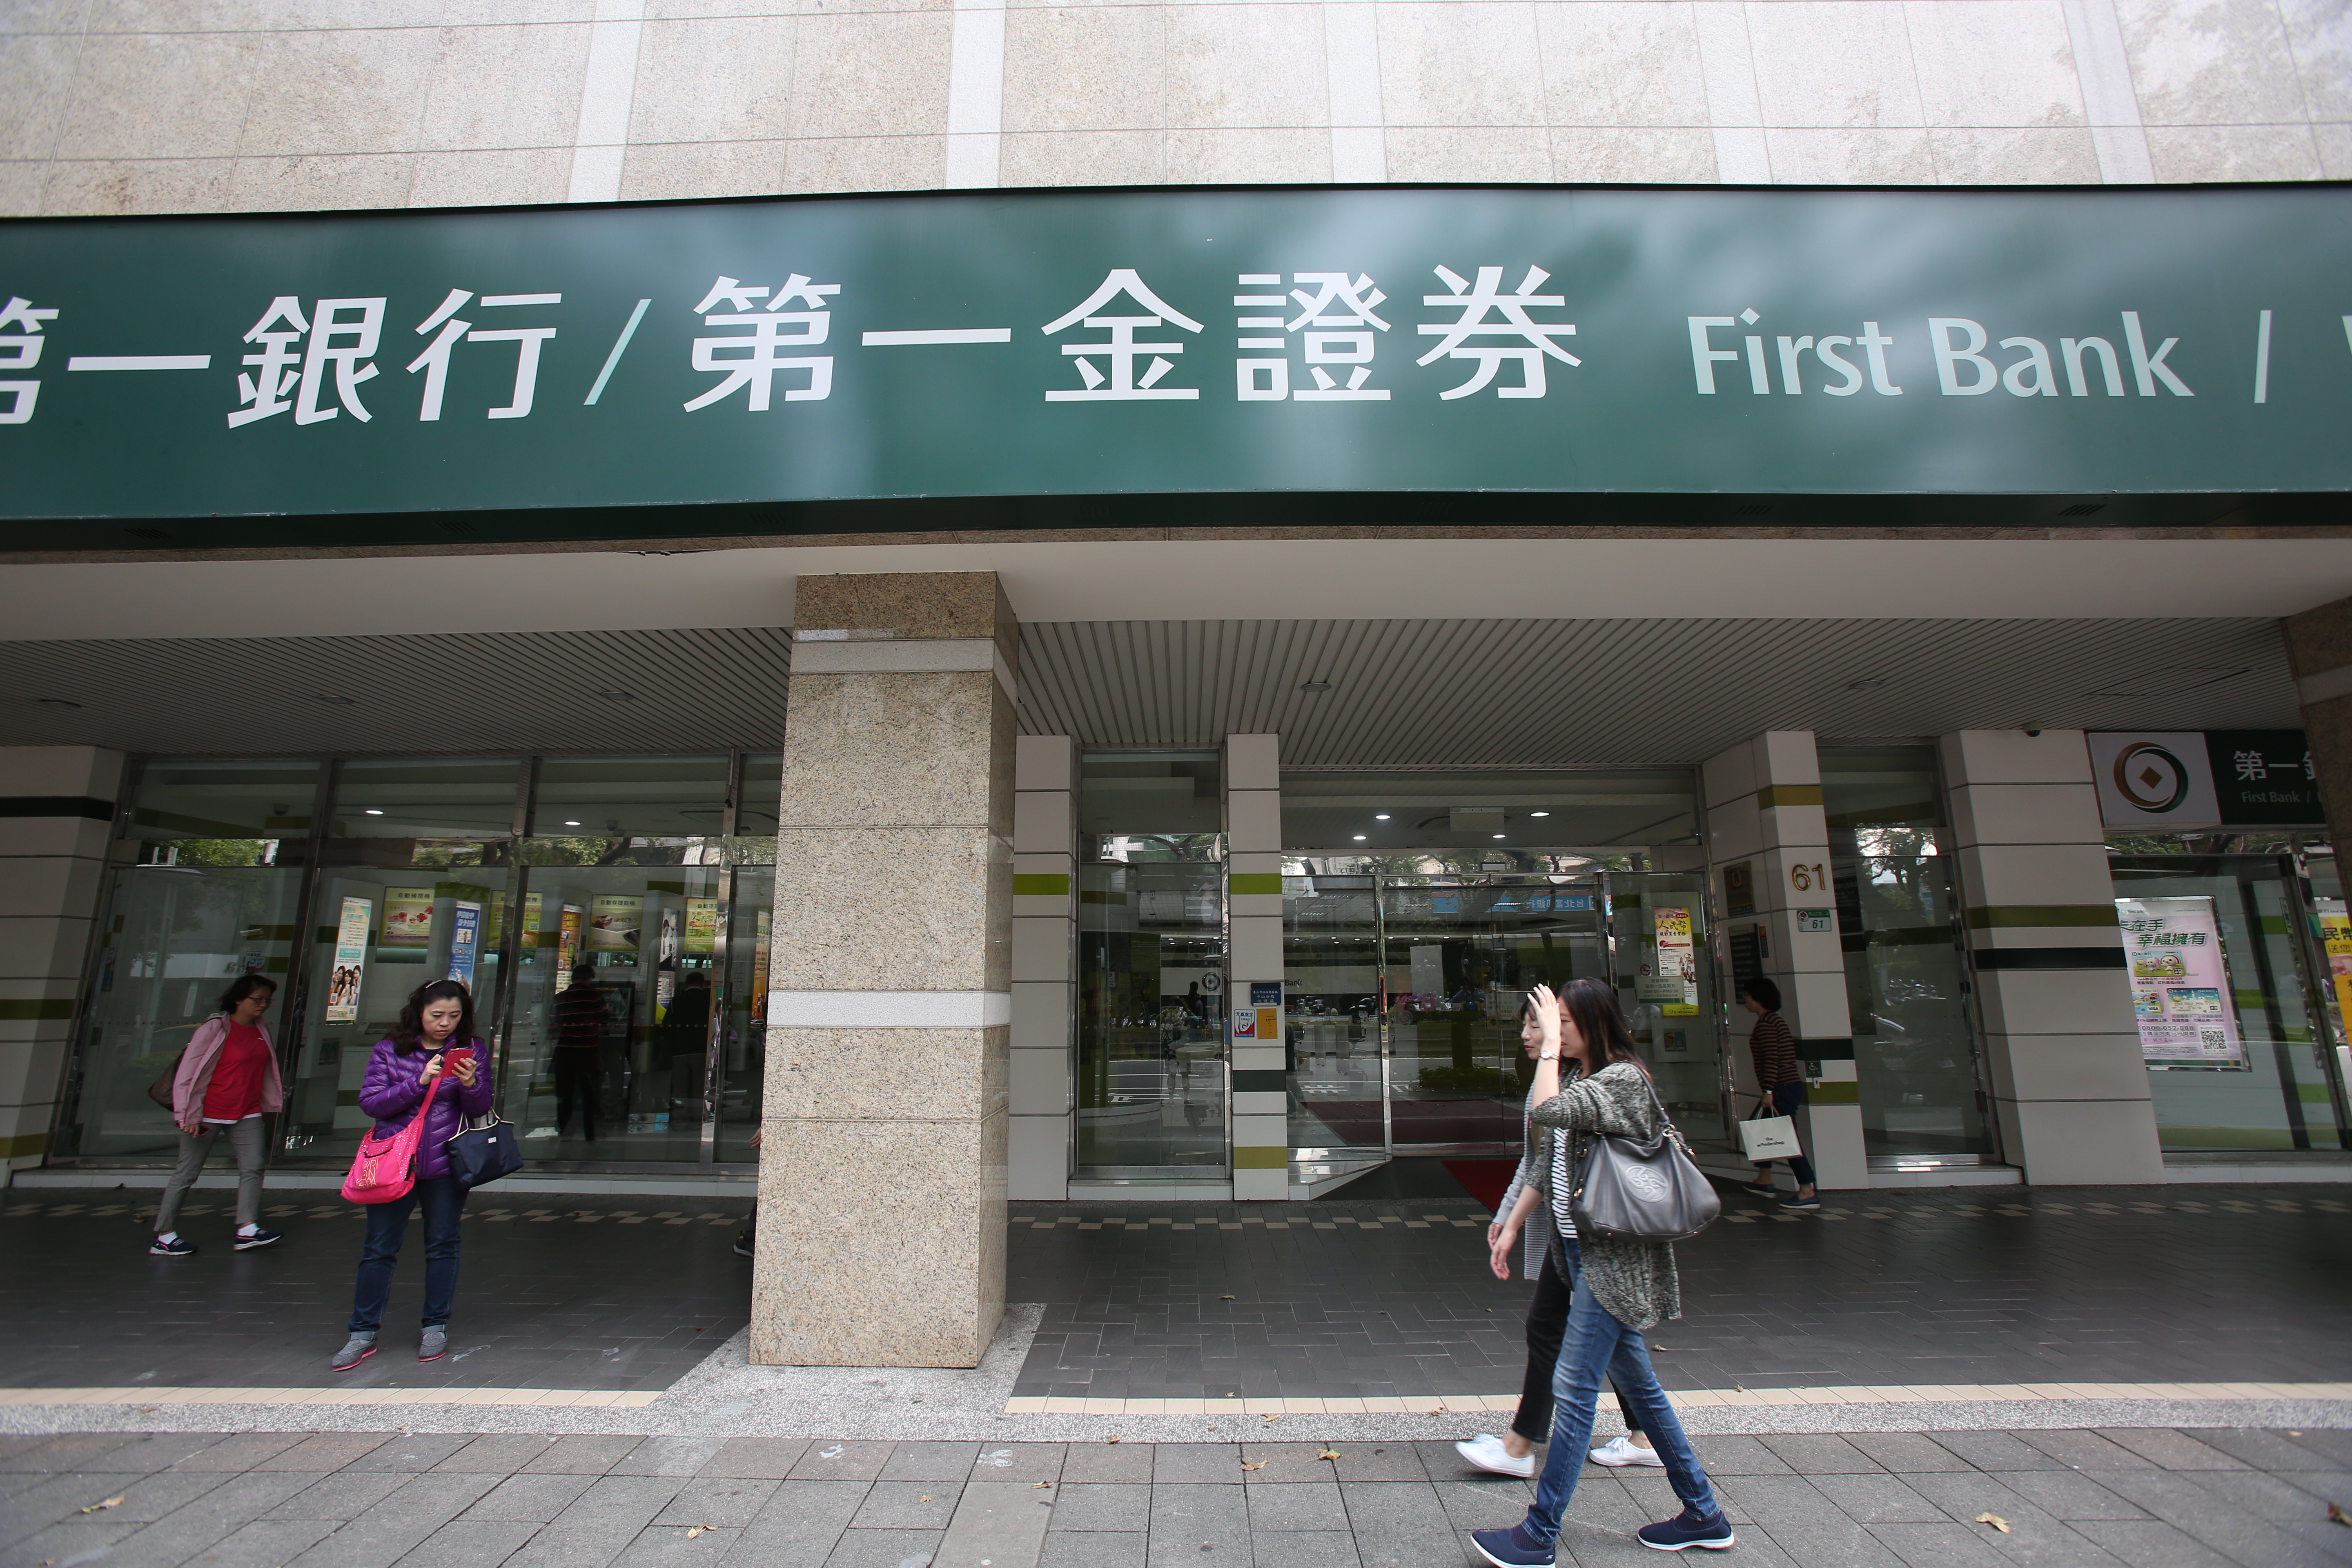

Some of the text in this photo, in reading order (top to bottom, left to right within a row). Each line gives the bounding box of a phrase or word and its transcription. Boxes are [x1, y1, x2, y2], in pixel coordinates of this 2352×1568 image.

[683, 264, 1582, 412] 第一金證券
[1688, 307, 1903, 396] First
[1928, 310, 2195, 397] Bank
[2241, 791, 2267, 803] First
[2269, 791, 2300, 803] Bank
[1792, 864, 1826, 891] 61
[1813, 920, 1823, 929] 61
[2137, 932, 2206, 948] 幸福擁有
